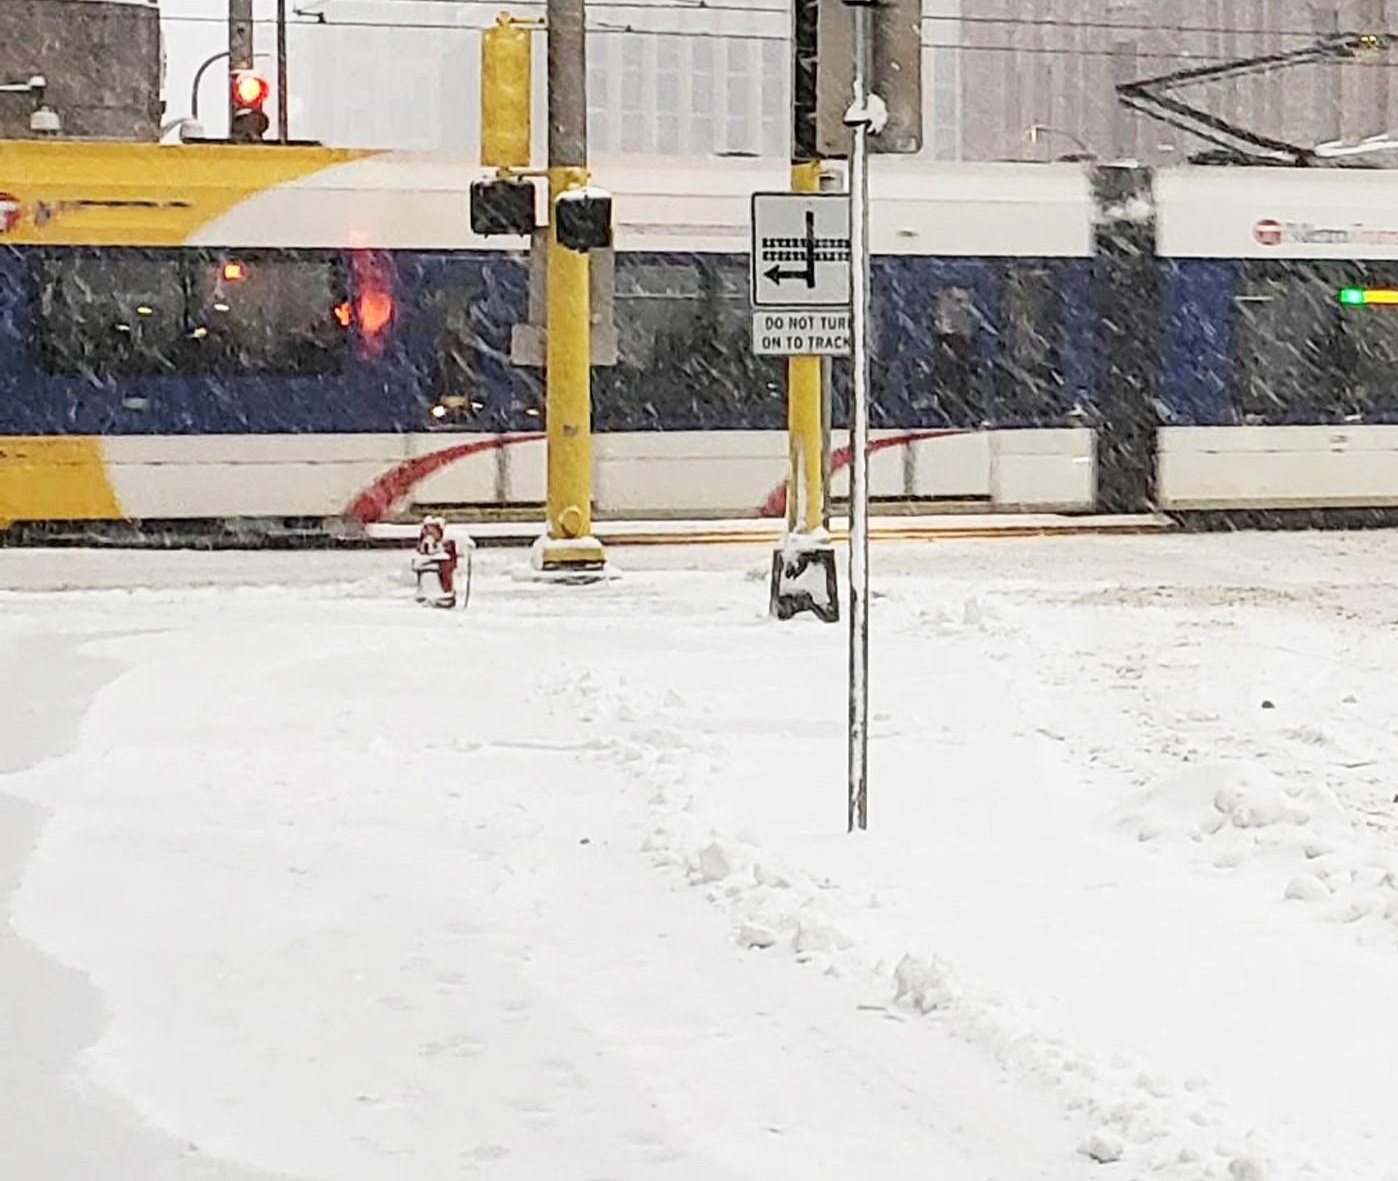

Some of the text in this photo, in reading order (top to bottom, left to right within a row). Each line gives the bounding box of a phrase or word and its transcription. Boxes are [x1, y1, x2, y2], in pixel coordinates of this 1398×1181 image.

[765, 317, 850, 330] DO NOT TUR
[762, 337, 780, 349] ON
[786, 337, 803, 349] TO
